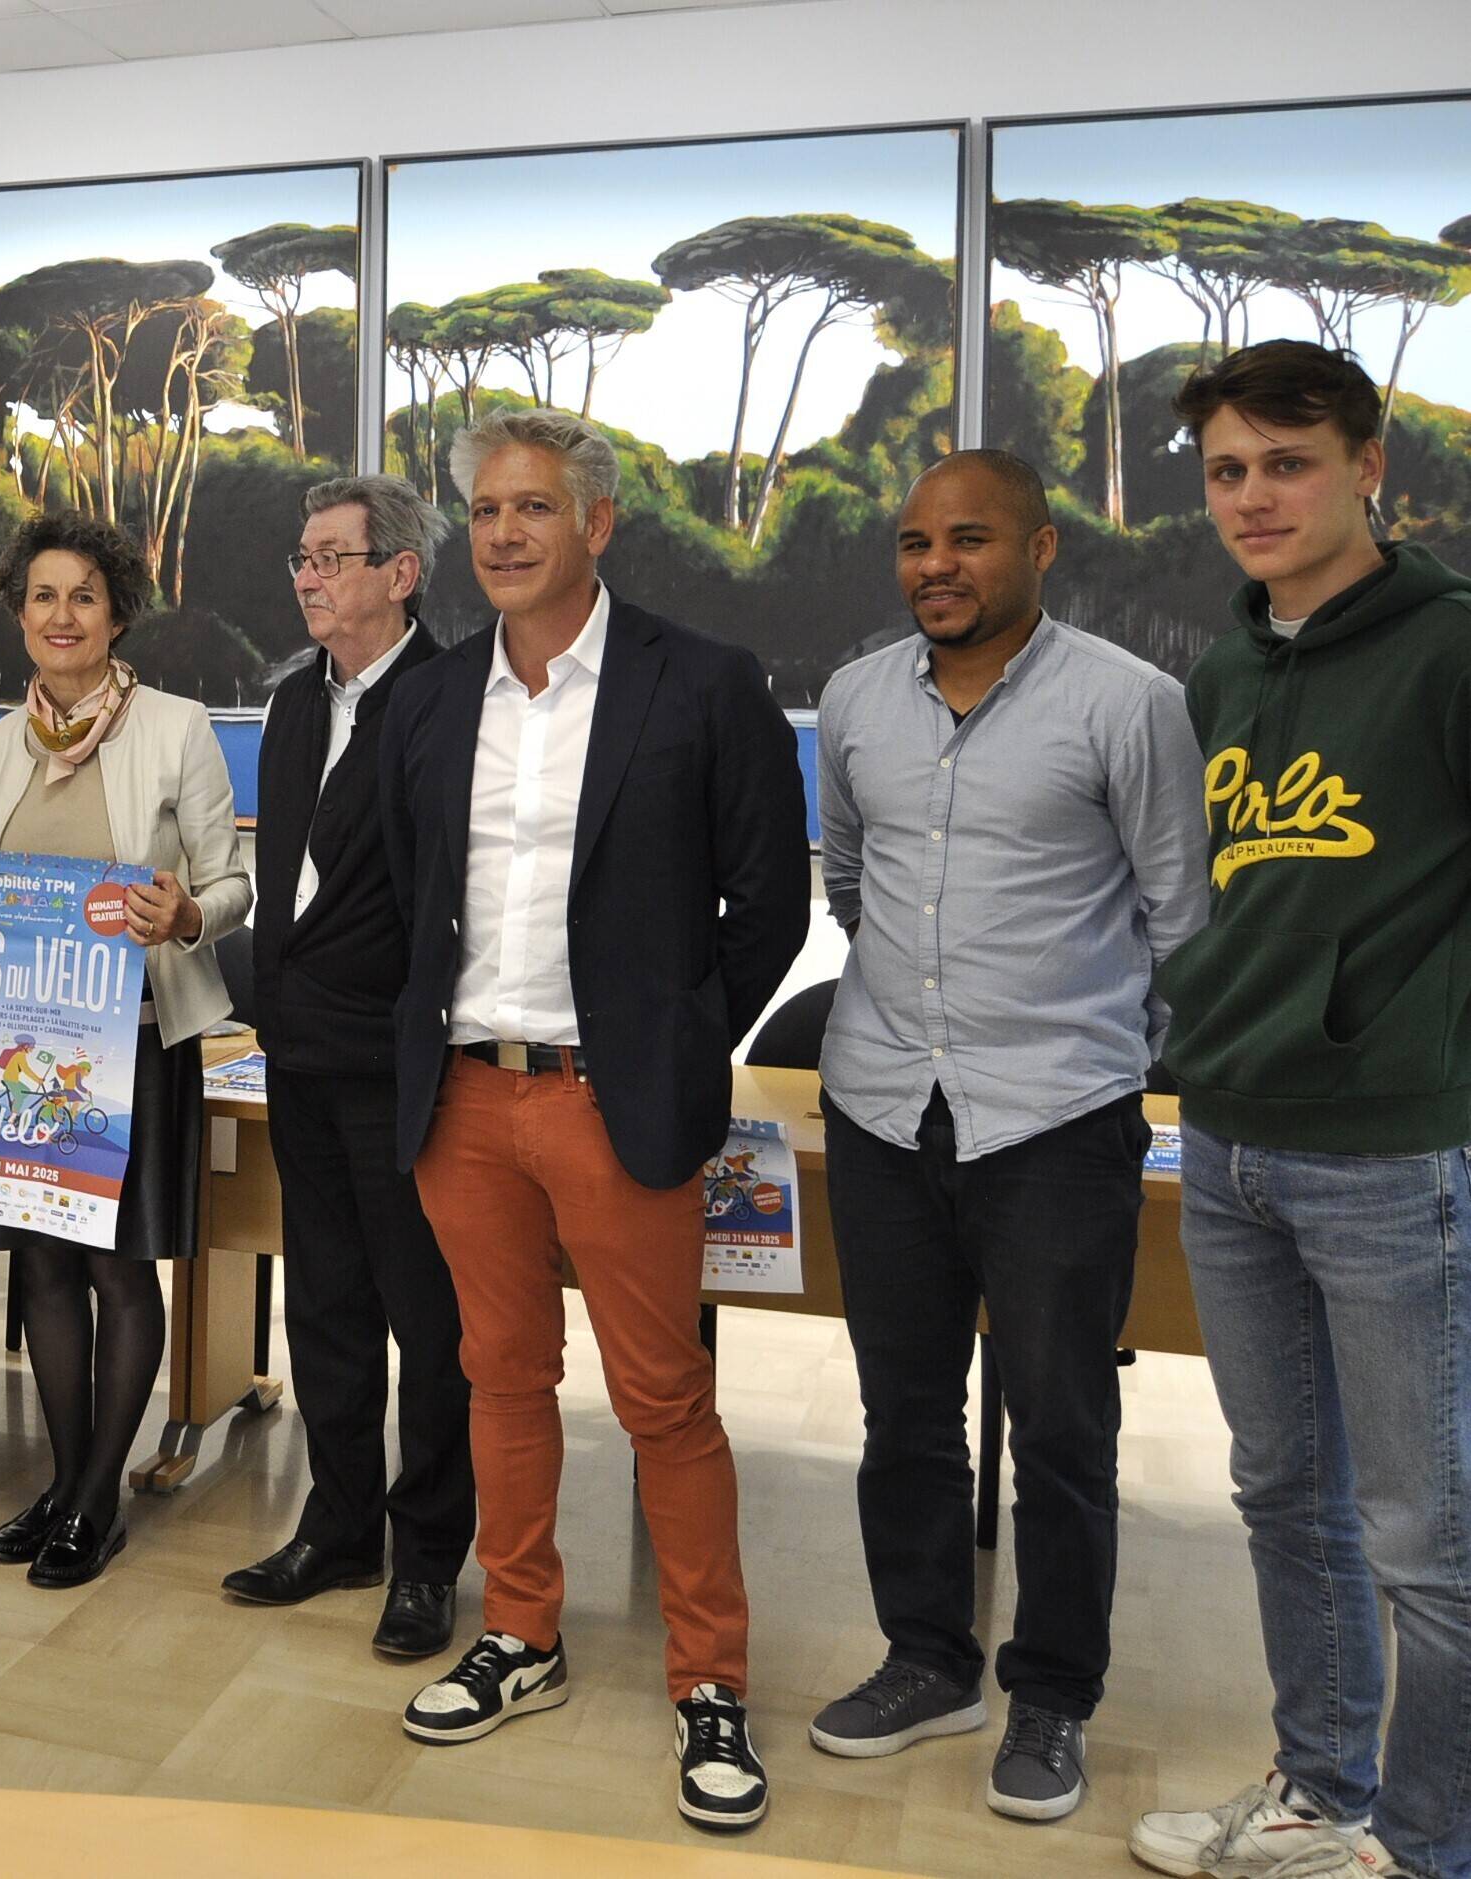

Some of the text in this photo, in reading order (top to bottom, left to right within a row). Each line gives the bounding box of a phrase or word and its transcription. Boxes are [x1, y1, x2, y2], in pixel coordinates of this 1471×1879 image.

[44, 879, 75, 894] TPM
[88, 899, 123, 912] ANIMATIO
[91, 911, 126, 922] GRATUITE
[6, 965, 30, 1000] DU
[35, 924, 111, 1012] VÉLO
[5, 1161, 29, 1176] MAI
[32, 1166, 59, 1182] 2025
[704, 1232, 780, 1245] AMEDI 31 MAI 2025
